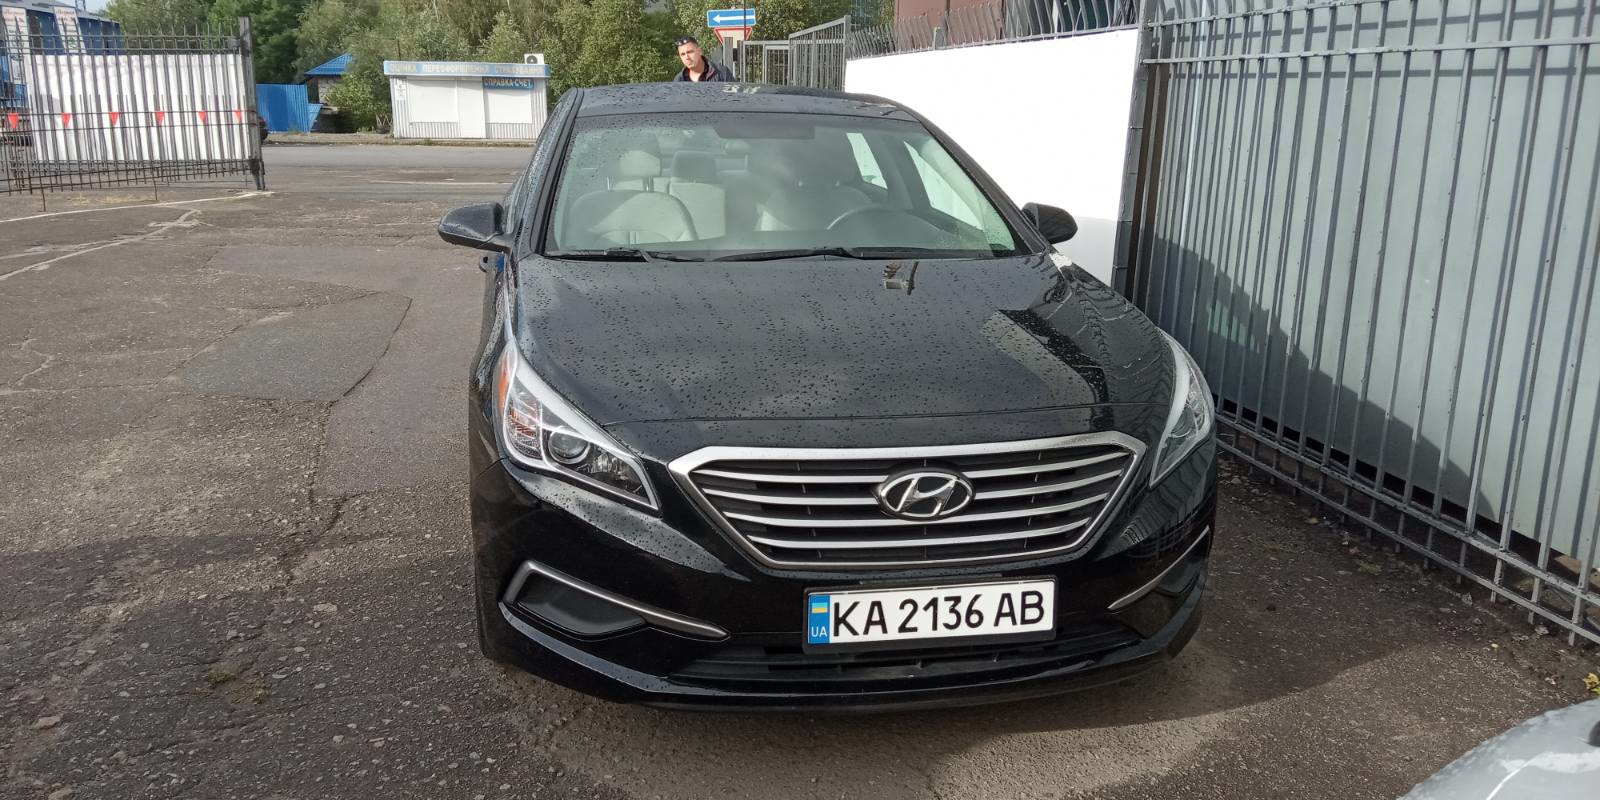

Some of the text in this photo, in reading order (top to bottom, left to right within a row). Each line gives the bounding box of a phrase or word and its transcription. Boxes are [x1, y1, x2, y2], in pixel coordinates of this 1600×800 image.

[833, 590, 1045, 637] KA 2136 AB
[811, 626, 828, 638] UA
